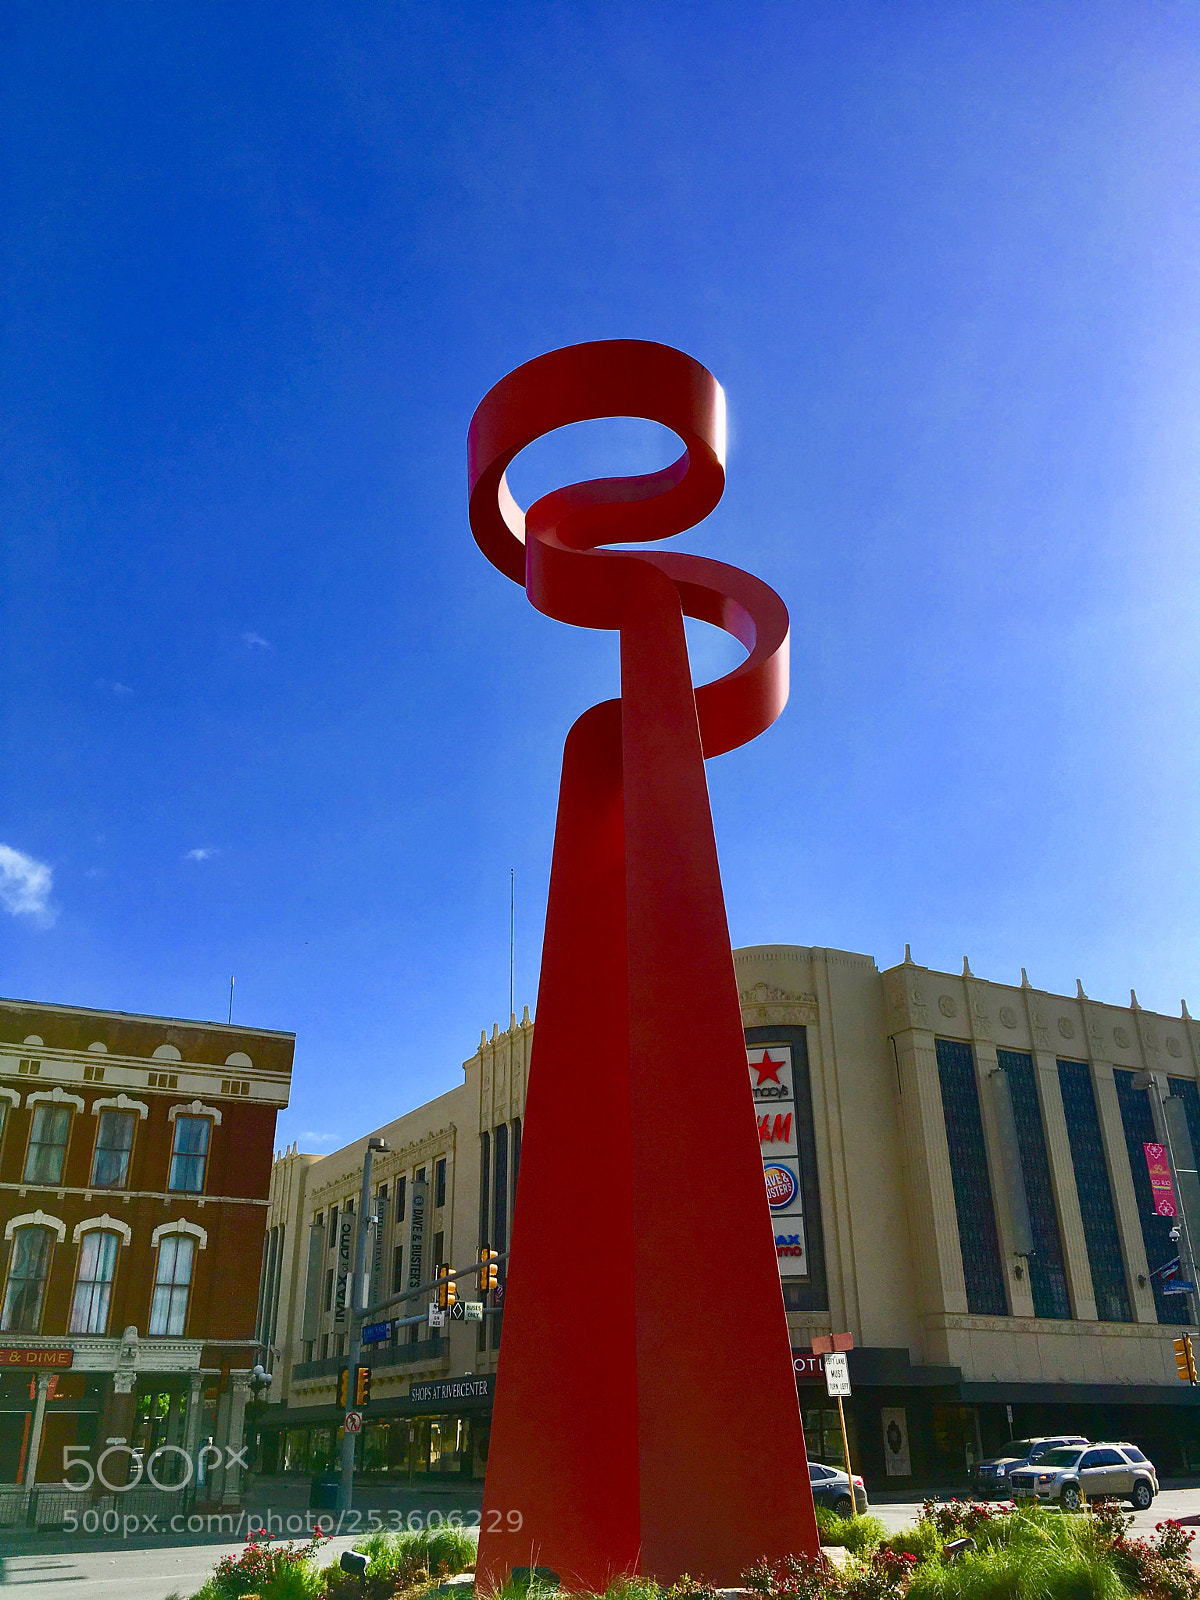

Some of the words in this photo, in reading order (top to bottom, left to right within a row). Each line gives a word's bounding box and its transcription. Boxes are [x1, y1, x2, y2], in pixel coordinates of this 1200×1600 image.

[765, 1173, 782, 1188] AVE
[781, 1172, 789, 1183] &
[767, 1182, 792, 1199] USTER'S
[413, 1209, 424, 1232] DAVE
[775, 1234, 801, 1246] AX
[410, 1245, 422, 1288] BUSTER'S
[335, 1274, 348, 1323] IMAX
[9, 1351, 21, 1362] &
[26, 1352, 69, 1363] DIME
[830, 1369, 844, 1378] MUST
[411, 1386, 432, 1401] SHOPS
[432, 1386, 441, 1399] AT
[441, 1380, 488, 1399] RIVERCENTER
